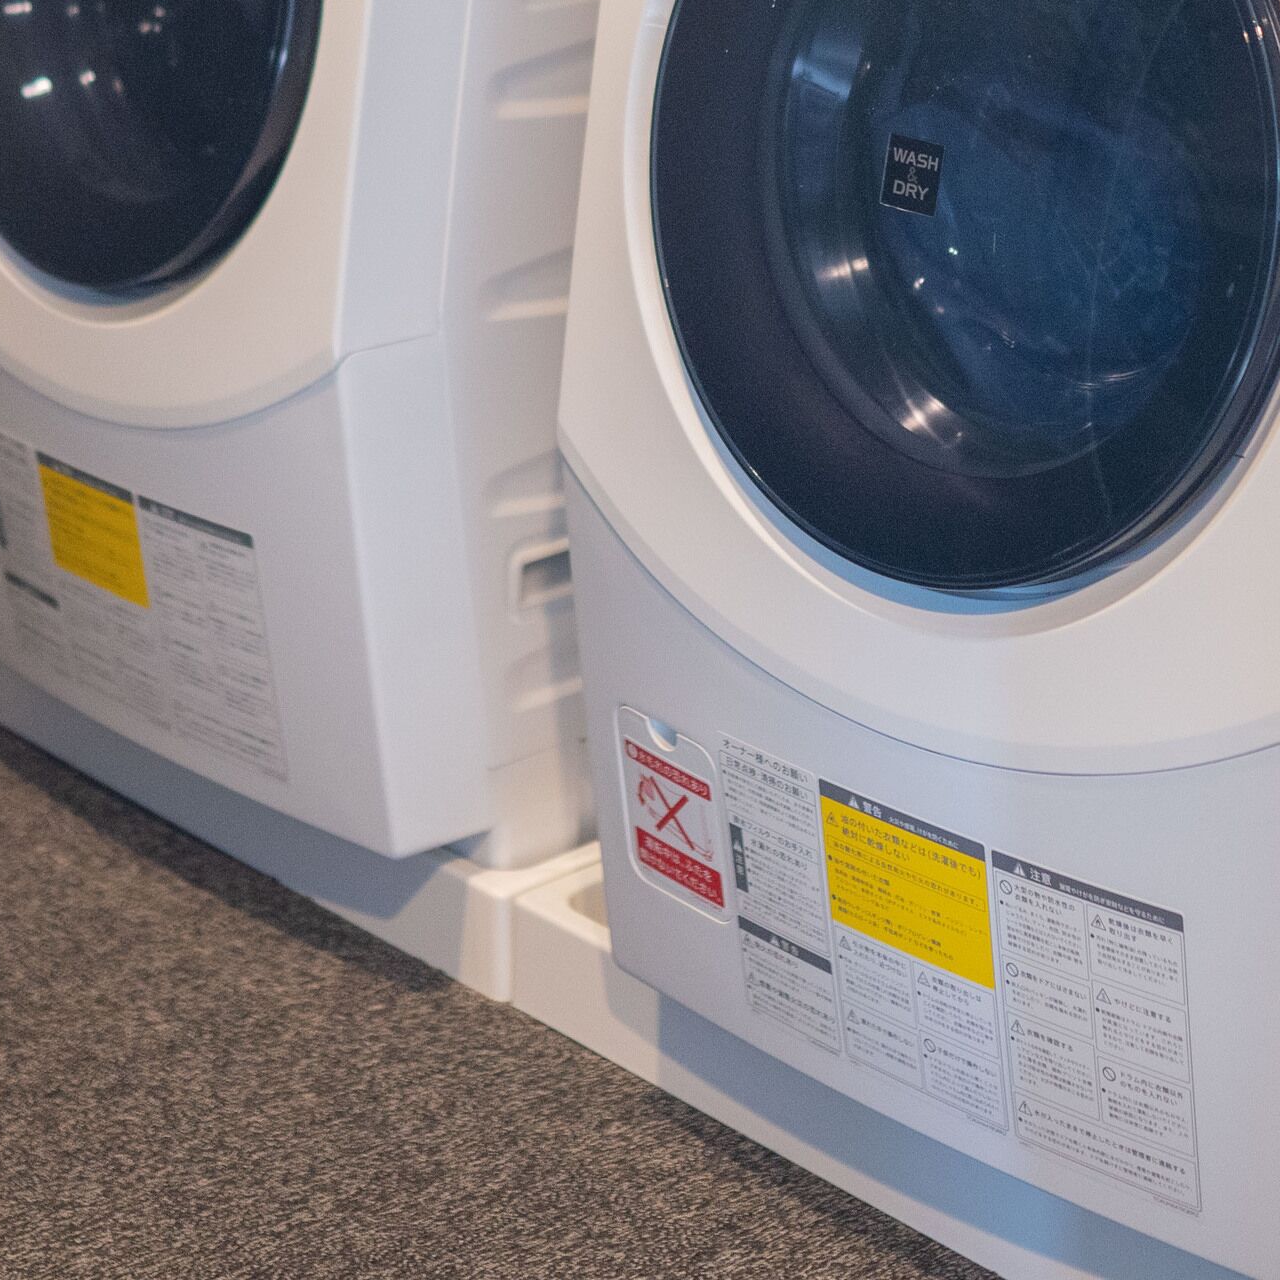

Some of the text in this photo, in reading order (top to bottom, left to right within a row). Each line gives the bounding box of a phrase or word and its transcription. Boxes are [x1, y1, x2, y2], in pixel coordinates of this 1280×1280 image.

[893, 147, 939, 172] WASH
[907, 166, 918, 183] &
[893, 179, 929, 200] DRY
